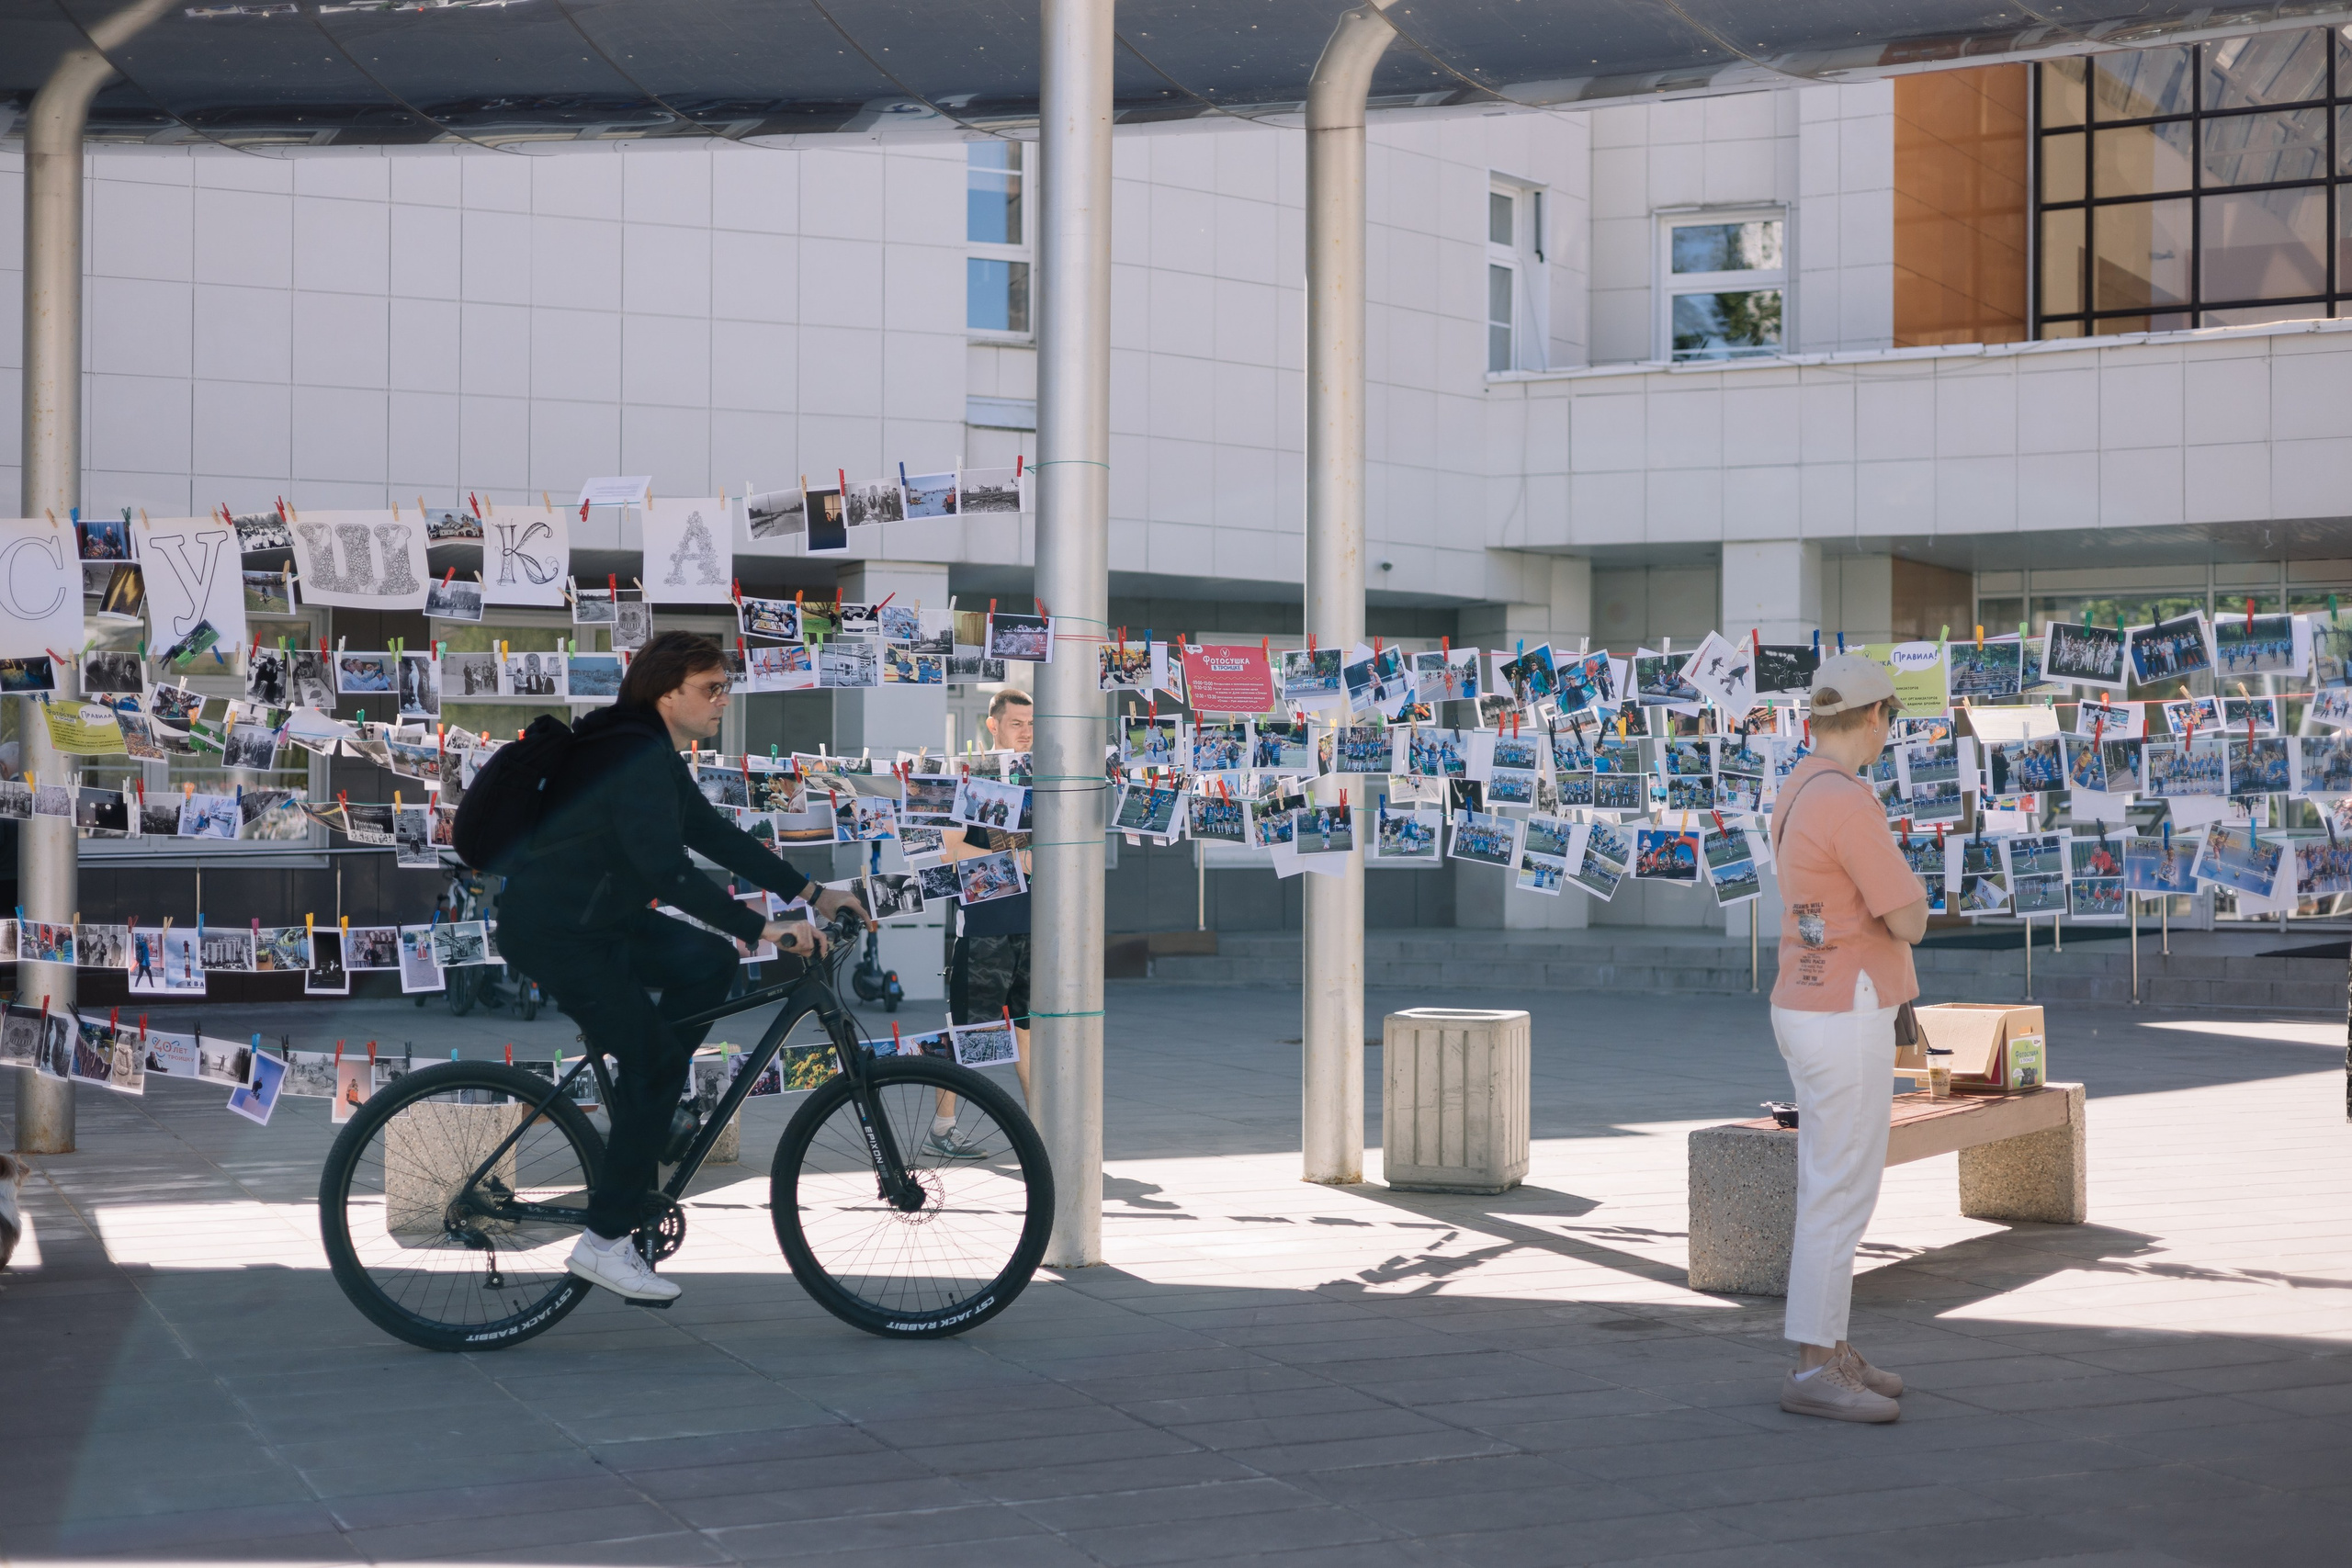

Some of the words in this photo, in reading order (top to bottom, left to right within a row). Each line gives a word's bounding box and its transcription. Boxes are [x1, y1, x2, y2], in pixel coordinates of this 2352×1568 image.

[663, 509, 727, 587] А
[173, 1046, 189, 1055] ЛЕТ
[865, 1125, 884, 1165] EPIXON
[554, 1287, 573, 1310] CST
[974, 1295, 995, 1314] CST
[521, 1306, 552, 1331] JACK
[885, 1321, 938, 1332] RABBIT
[939, 1309, 973, 1328] JACK
[465, 1325, 519, 1342] RABBIT
